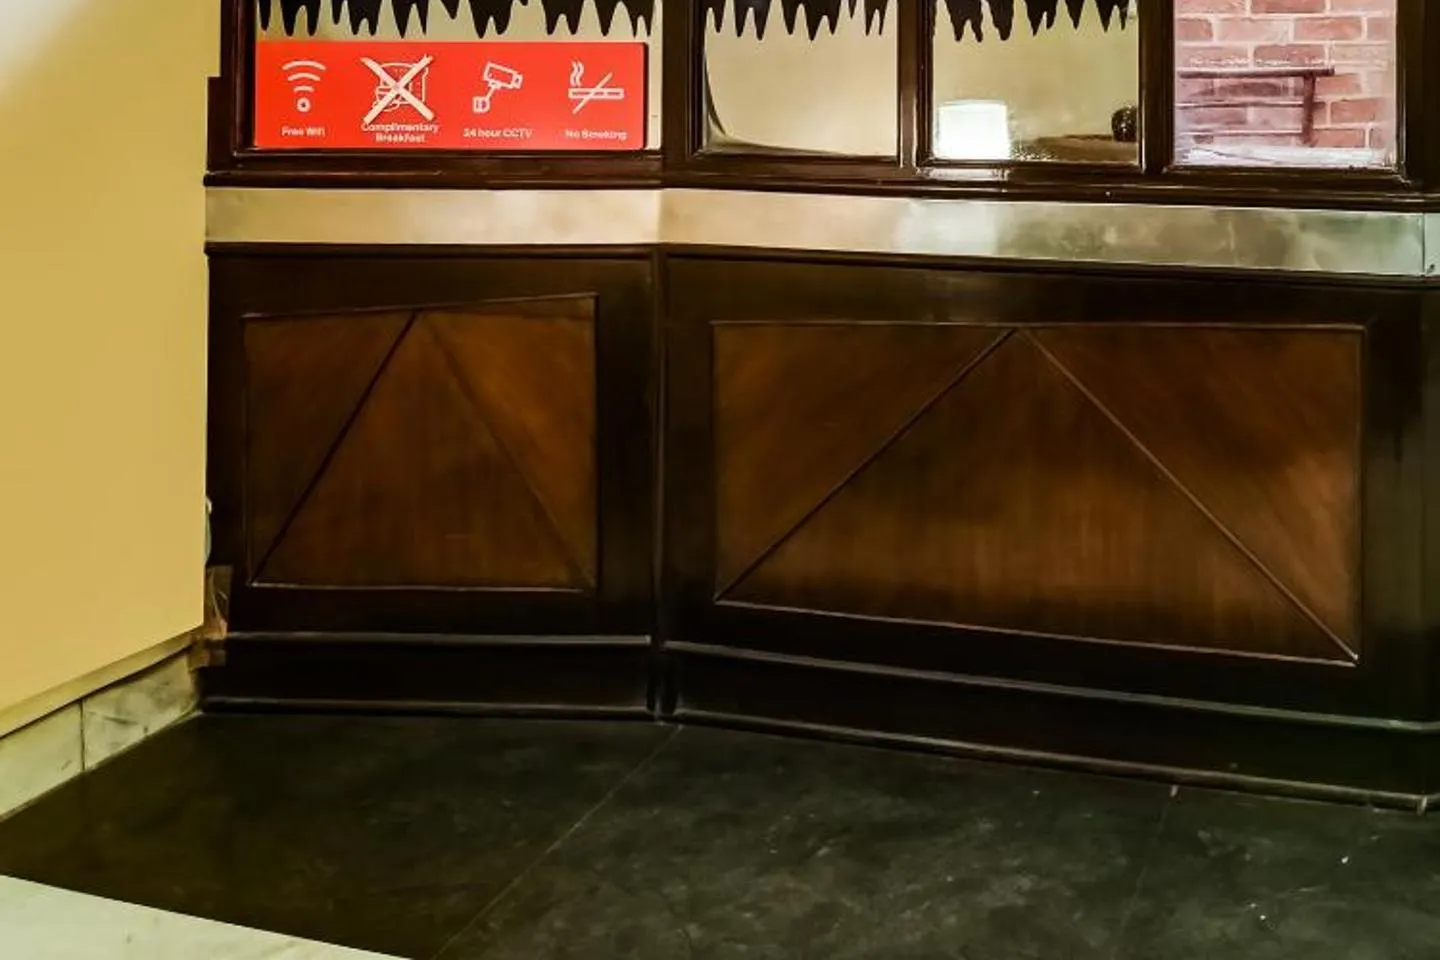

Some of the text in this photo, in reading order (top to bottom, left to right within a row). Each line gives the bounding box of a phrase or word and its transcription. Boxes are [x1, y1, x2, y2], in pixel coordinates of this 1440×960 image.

[281, 126, 304, 137] Free
[361, 122, 439, 134] Complimentary
[463, 128, 533, 138] 24 hour CCTV
[375, 133, 426, 143] Breakfast
[565, 130, 628, 141] No Smoking
